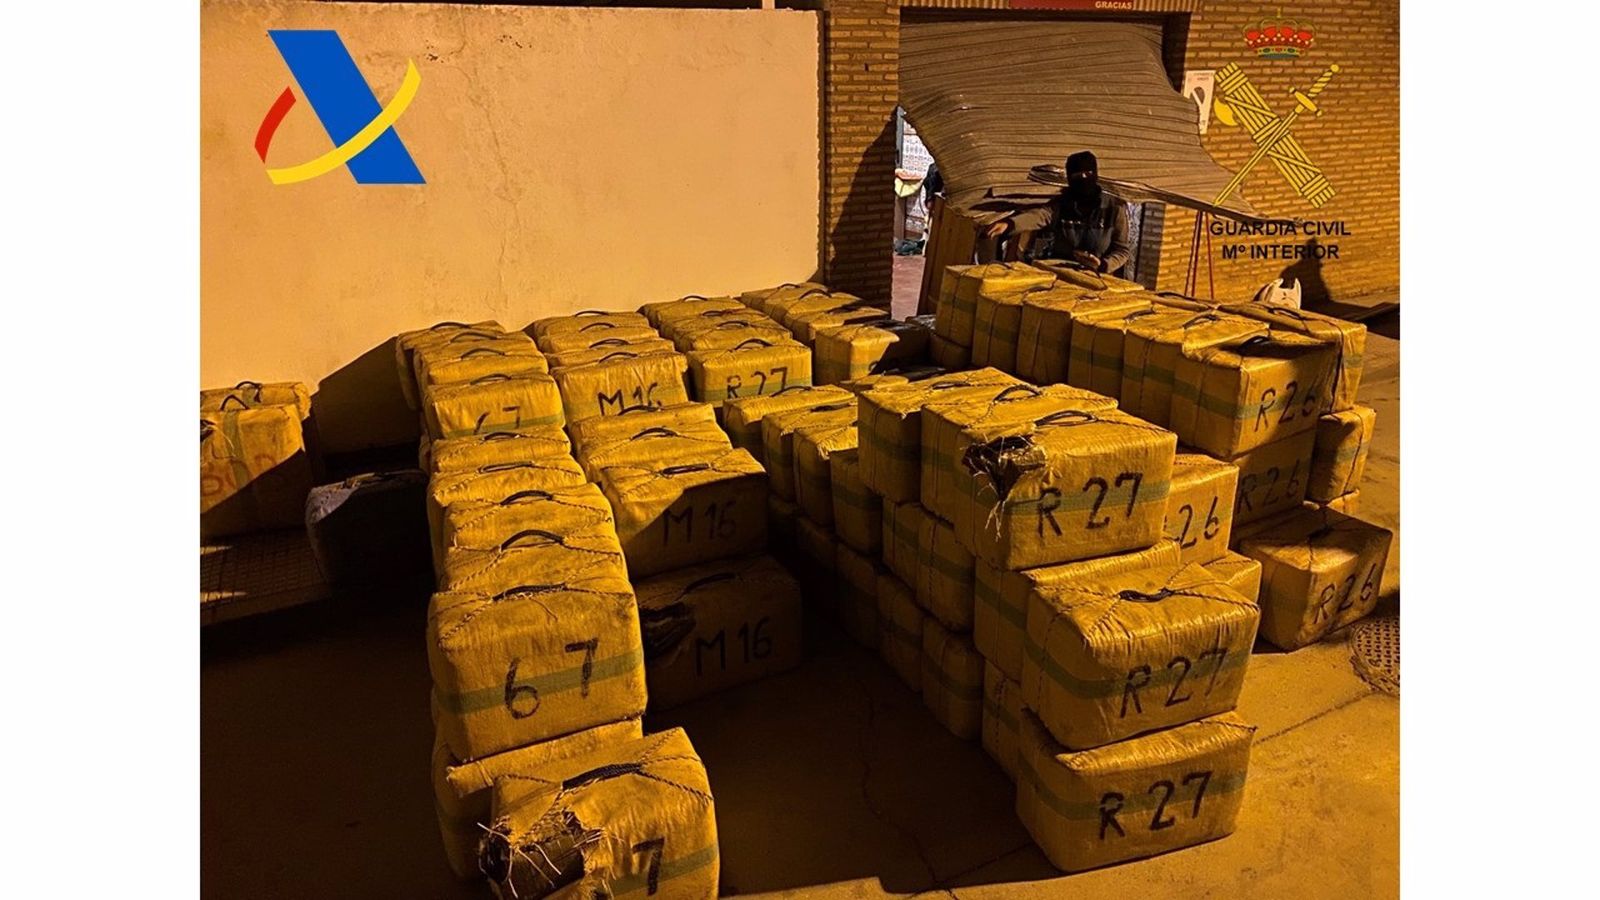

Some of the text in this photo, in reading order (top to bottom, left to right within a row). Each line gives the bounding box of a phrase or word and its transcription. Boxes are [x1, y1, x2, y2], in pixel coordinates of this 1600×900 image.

[1095, 1, 1133, 10] GRACIAS
[598, 389, 625, 416] M
[727, 374, 742, 399] R
[1254, 388, 1276, 432] R
[1037, 487, 1062, 539] R
[1082, 471, 1143, 530] 27
[1237, 458, 1299, 514] R 26
[663, 500, 737, 546] M 16
[1314, 563, 1373, 625] R 26
[696, 616, 773, 677] M 16
[1120, 647, 1228, 719] R 27
[1100, 771, 1213, 840] R 27
